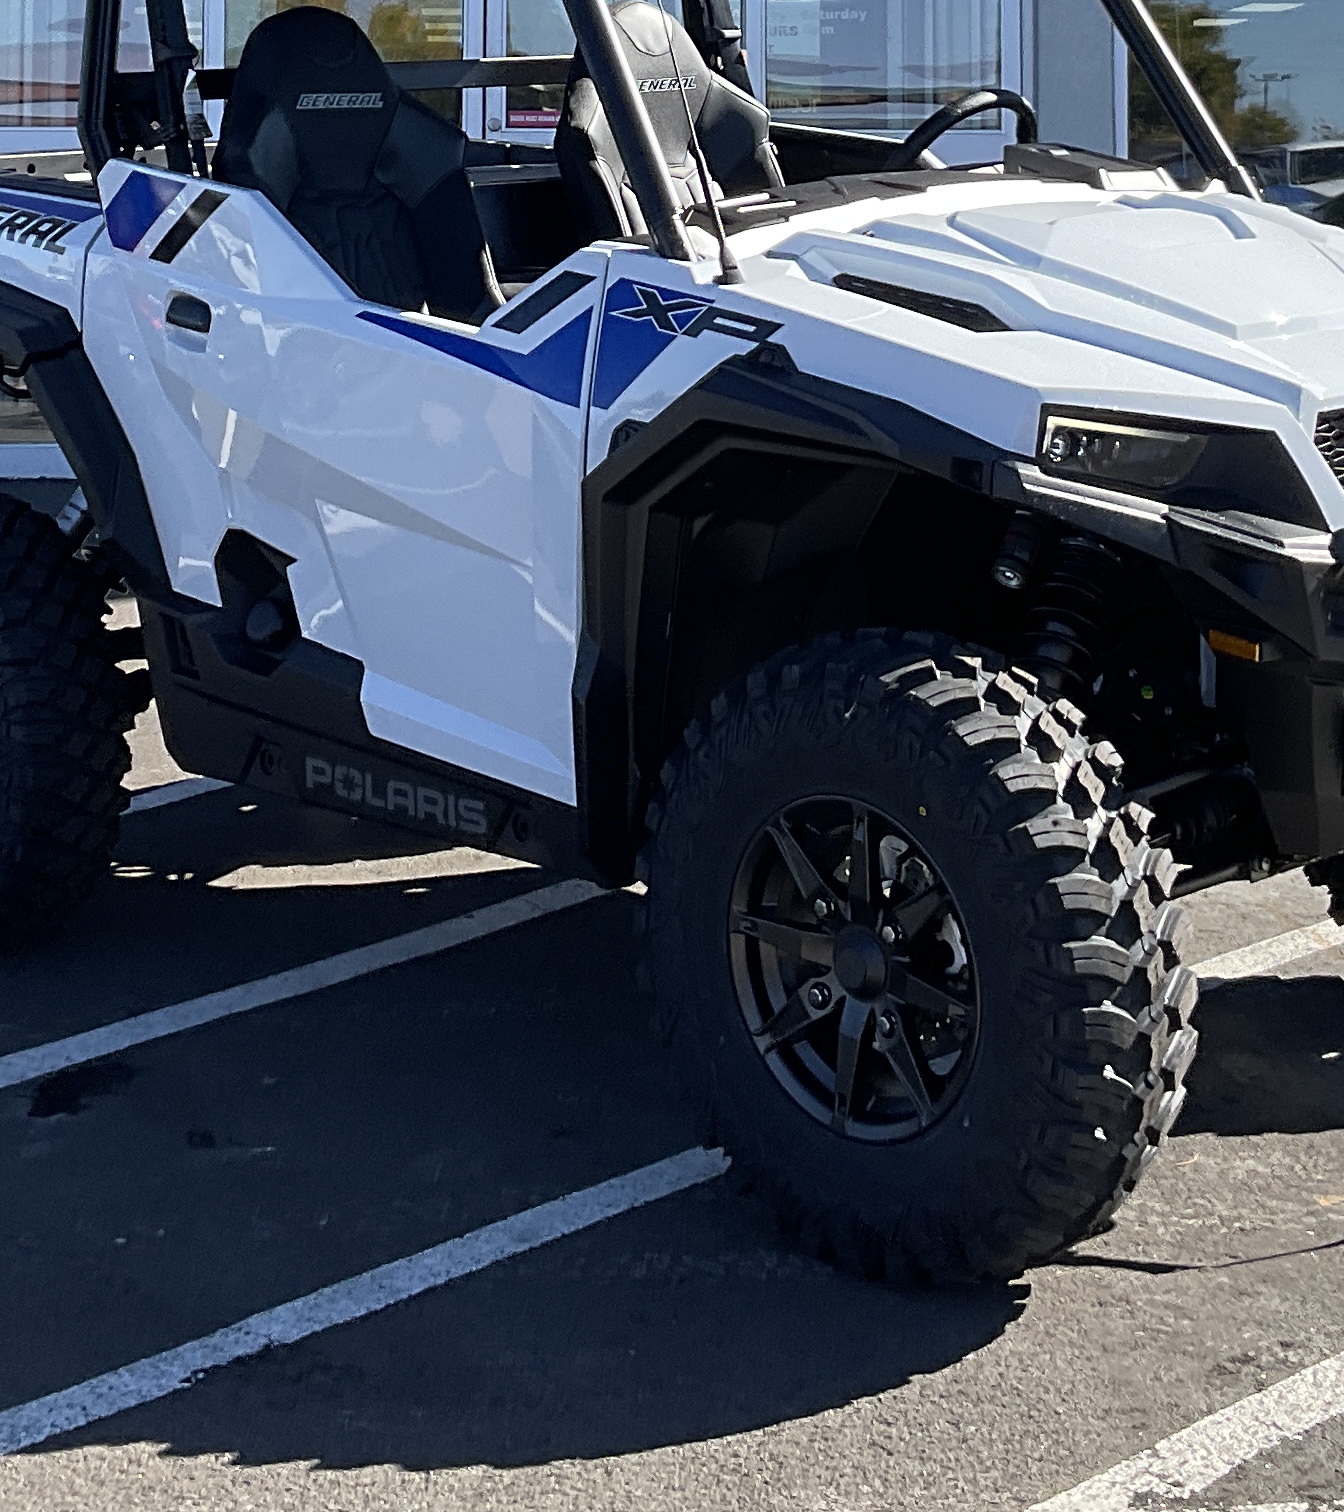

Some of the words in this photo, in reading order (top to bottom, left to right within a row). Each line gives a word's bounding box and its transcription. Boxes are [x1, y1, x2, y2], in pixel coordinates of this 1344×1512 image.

[297, 93, 384, 109] GENERAL
[637, 76, 696, 92] ENERAL
[609, 284, 785, 341] XP
[306, 755, 488, 834] POLARIS
